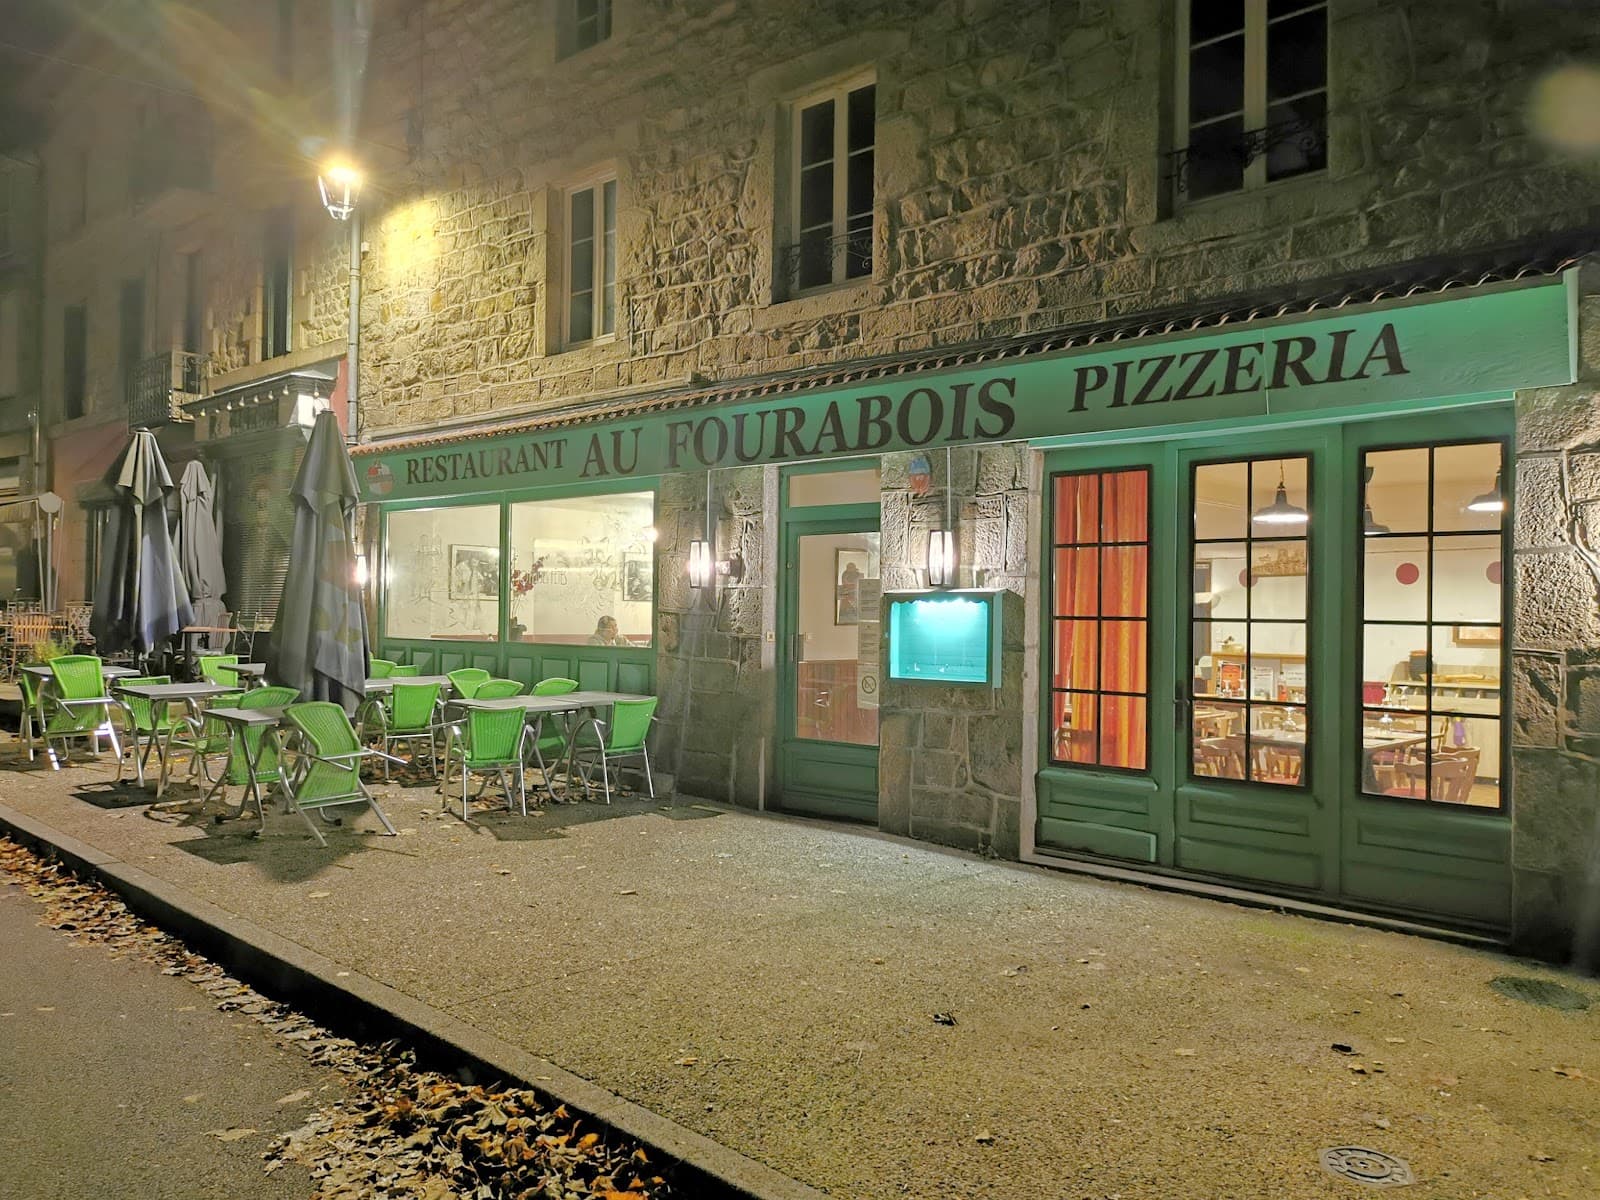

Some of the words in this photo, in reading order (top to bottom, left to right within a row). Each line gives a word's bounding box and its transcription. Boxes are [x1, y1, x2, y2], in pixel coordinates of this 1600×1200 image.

[406, 439, 567, 485] RESTAURANT
[579, 427, 641, 477] AU
[667, 378, 1015, 468] FOURABOIS
[1068, 323, 1410, 412] PIZZERIA
